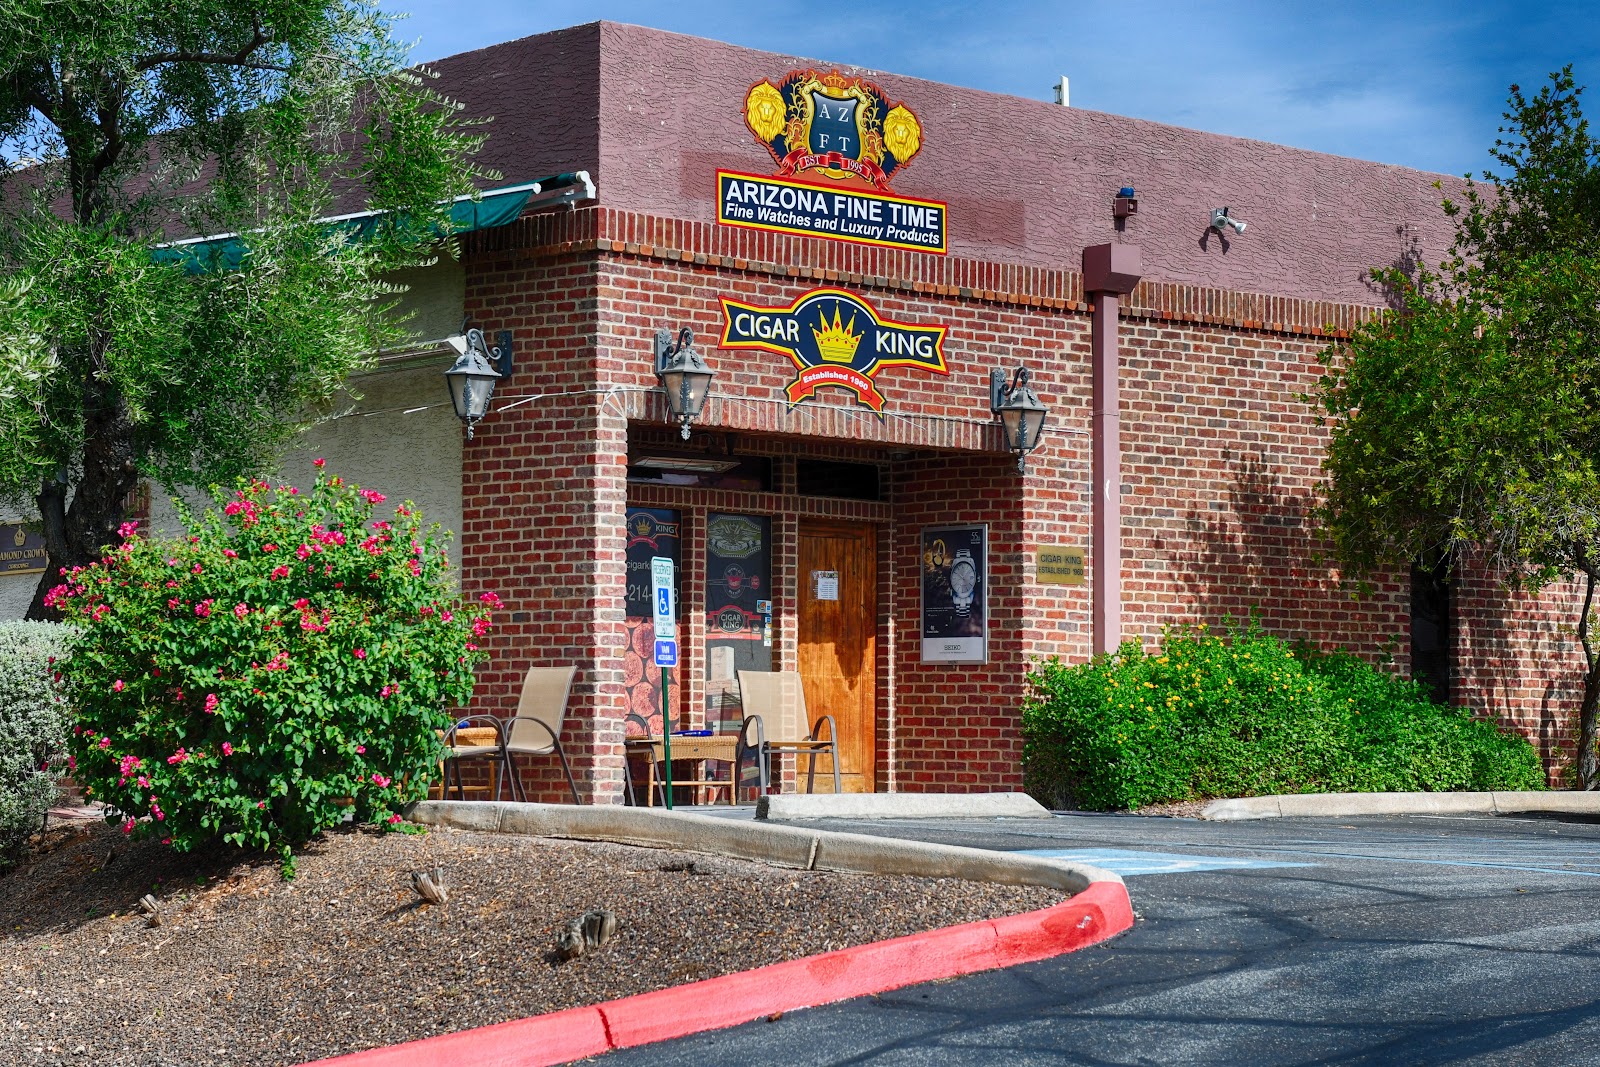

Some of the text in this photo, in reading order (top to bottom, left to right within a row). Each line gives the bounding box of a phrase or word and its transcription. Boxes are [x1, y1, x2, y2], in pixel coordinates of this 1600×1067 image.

[818, 104, 849, 123] A Z
[818, 134, 851, 152] F T
[804, 155, 863, 172] EST 1995
[726, 180, 939, 230] ARIZONA FINE TIME
[725, 202, 940, 245] Fine Watches and Luxury Products
[735, 312, 933, 358] CIGAR KING
[803, 371, 869, 391] Established 1960
[655, 524, 675, 534] KING
[23, 548, 46, 559] CROWN
[1040, 554, 1082, 565] CIGAR KING
[1038, 566, 1071, 575] ESTABLISHED
[720, 613, 741, 622] CIGAR
[722, 621, 740, 629] KING
